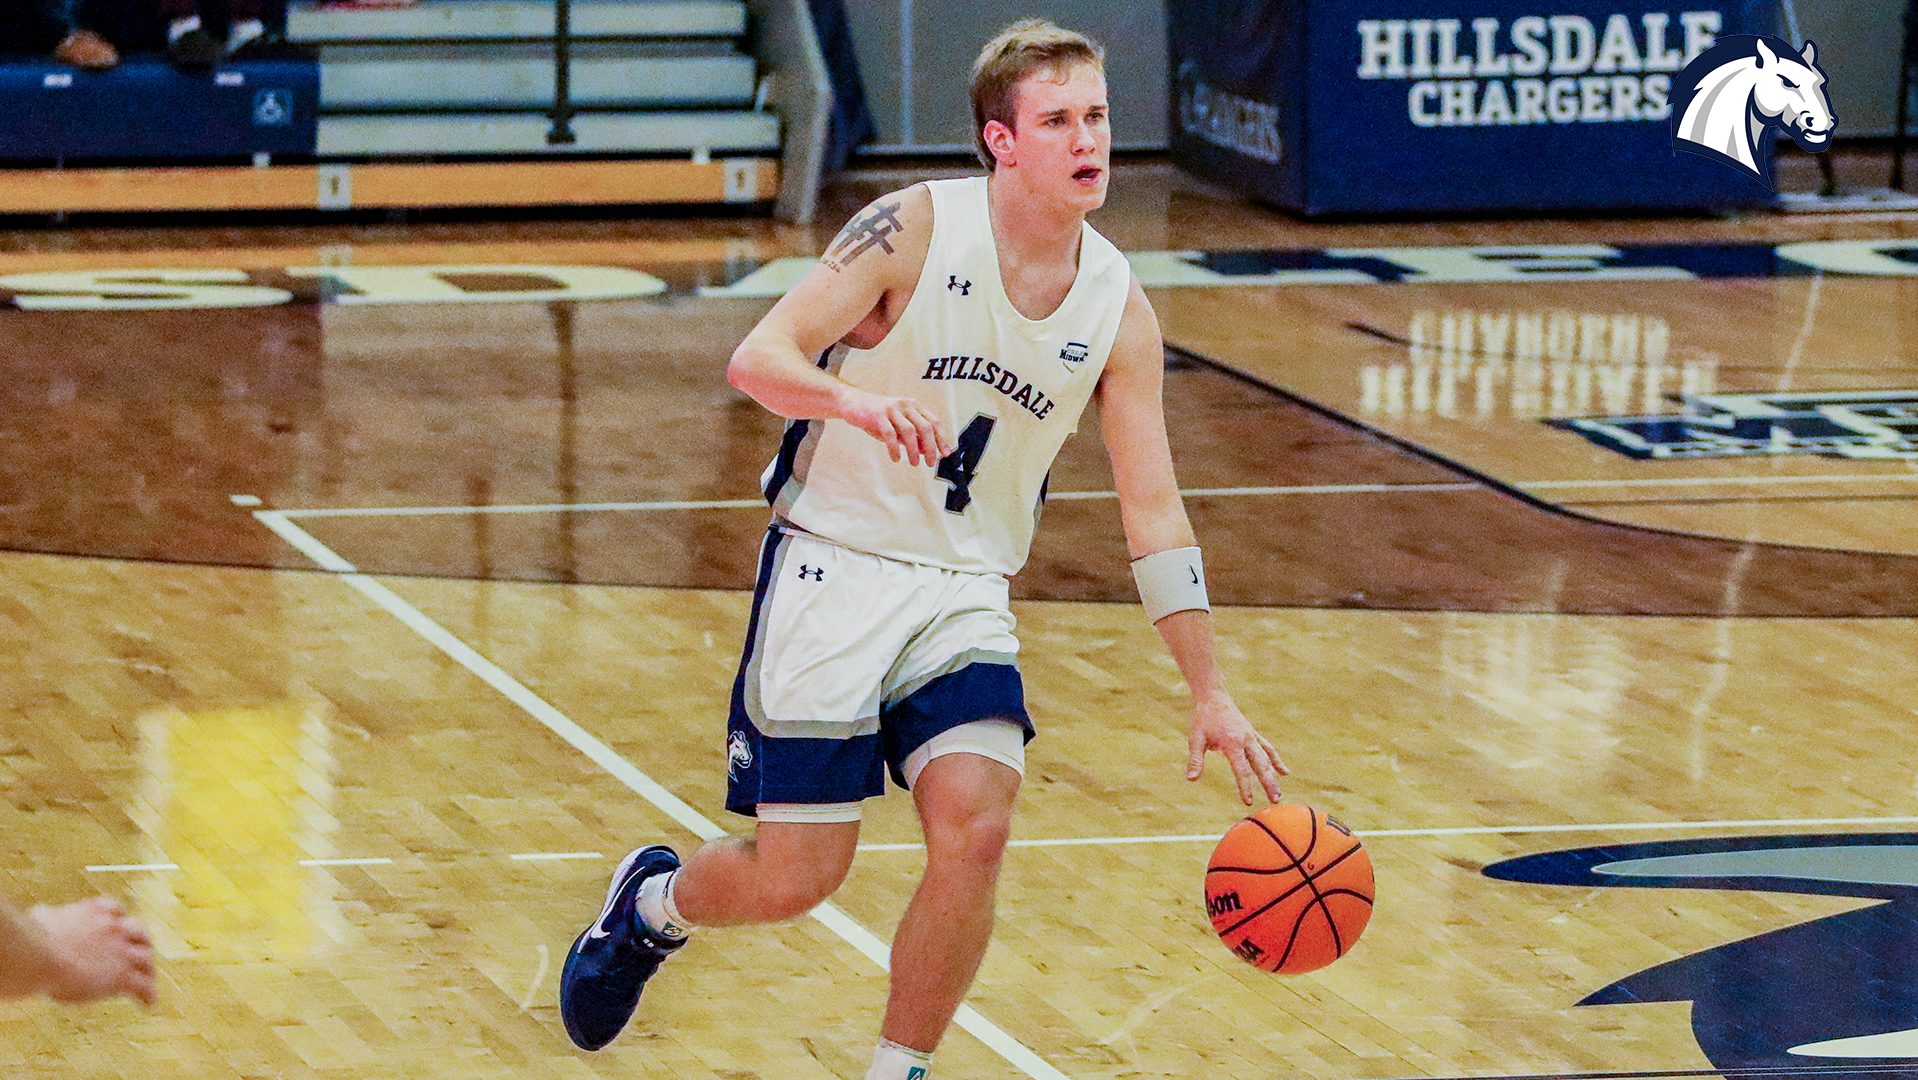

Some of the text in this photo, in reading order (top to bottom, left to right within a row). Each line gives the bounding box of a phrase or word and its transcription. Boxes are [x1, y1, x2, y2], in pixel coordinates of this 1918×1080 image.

[1407, 74, 1672, 128] CHARGERS
[921, 355, 1055, 421] HILLSDALE
[934, 411, 998, 516] 4
